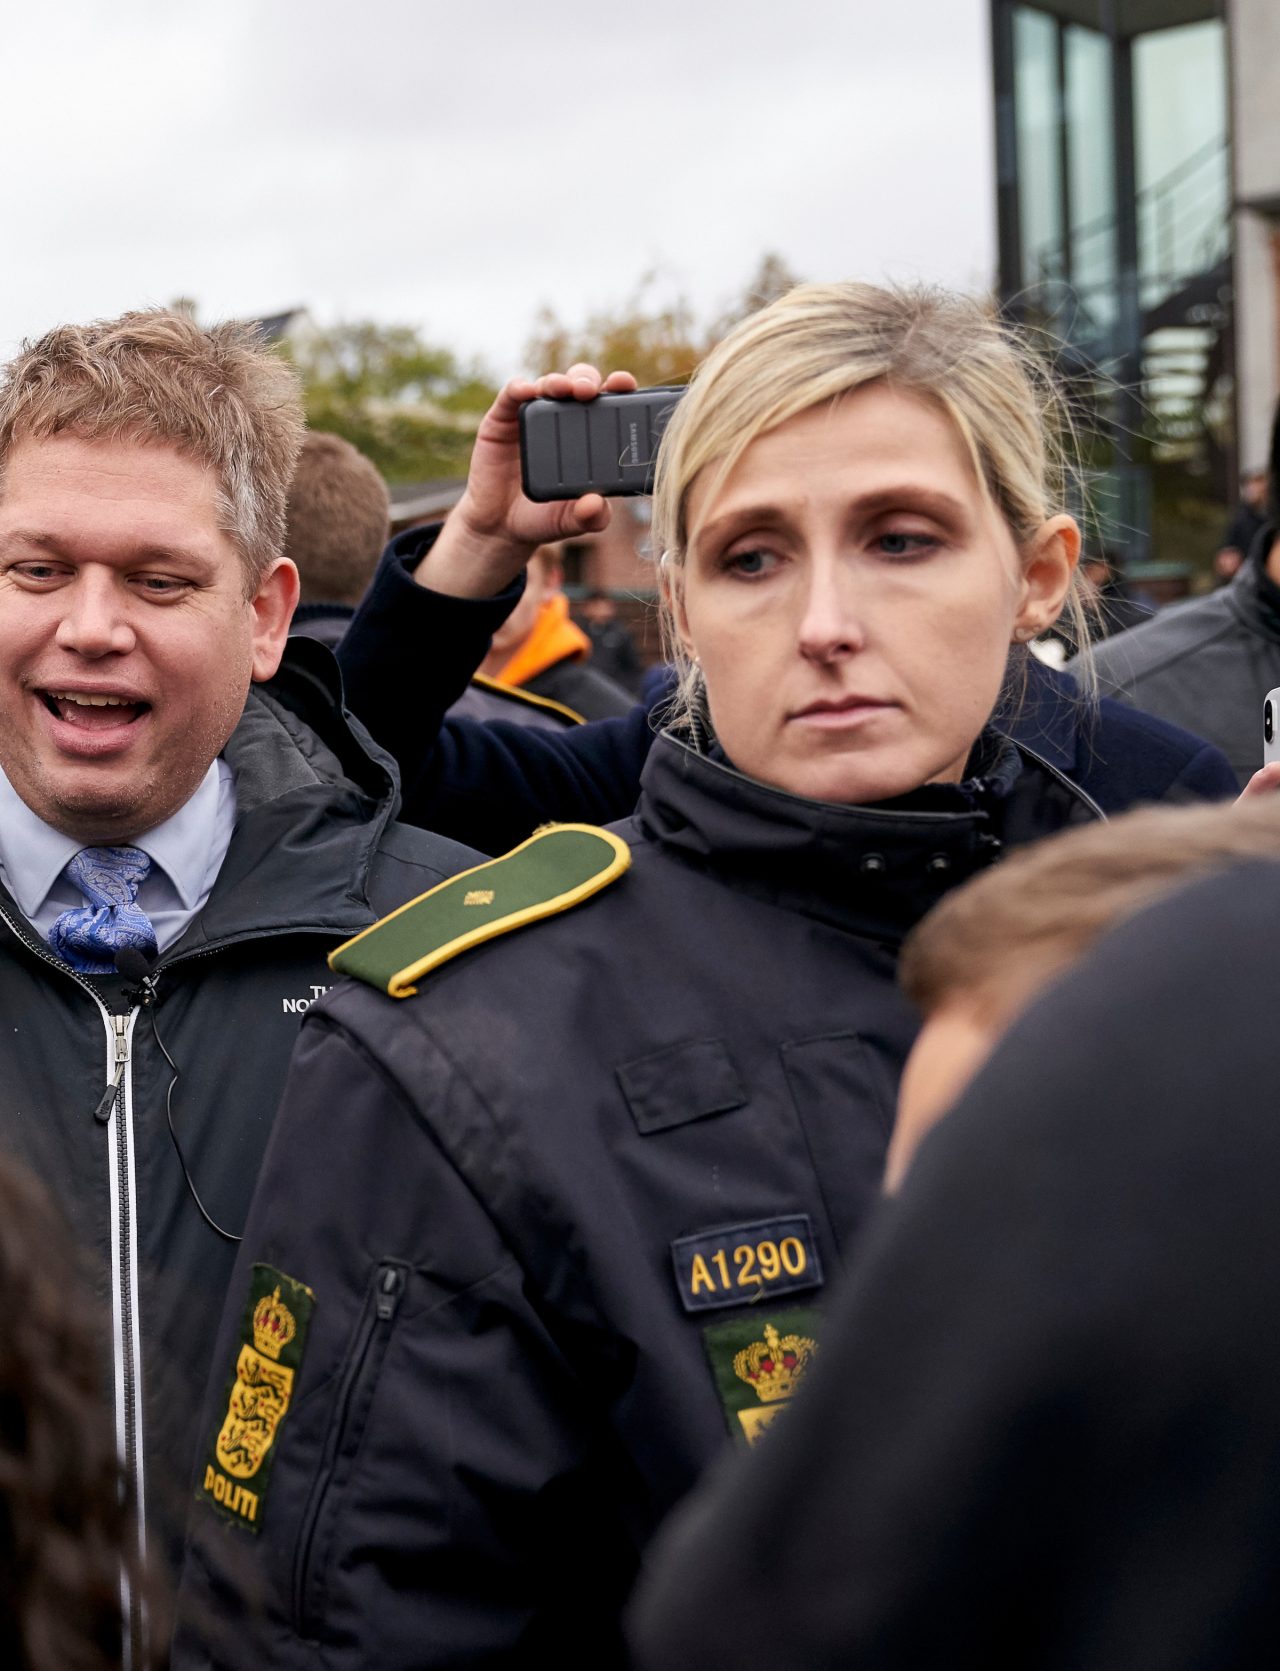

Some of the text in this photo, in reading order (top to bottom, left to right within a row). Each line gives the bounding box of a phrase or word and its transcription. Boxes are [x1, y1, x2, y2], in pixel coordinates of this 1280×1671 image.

[629, 422, 639, 465] SAMSUNG
[691, 1236, 806, 1295] A1290
[204, 1464, 258, 1521] POLITI
